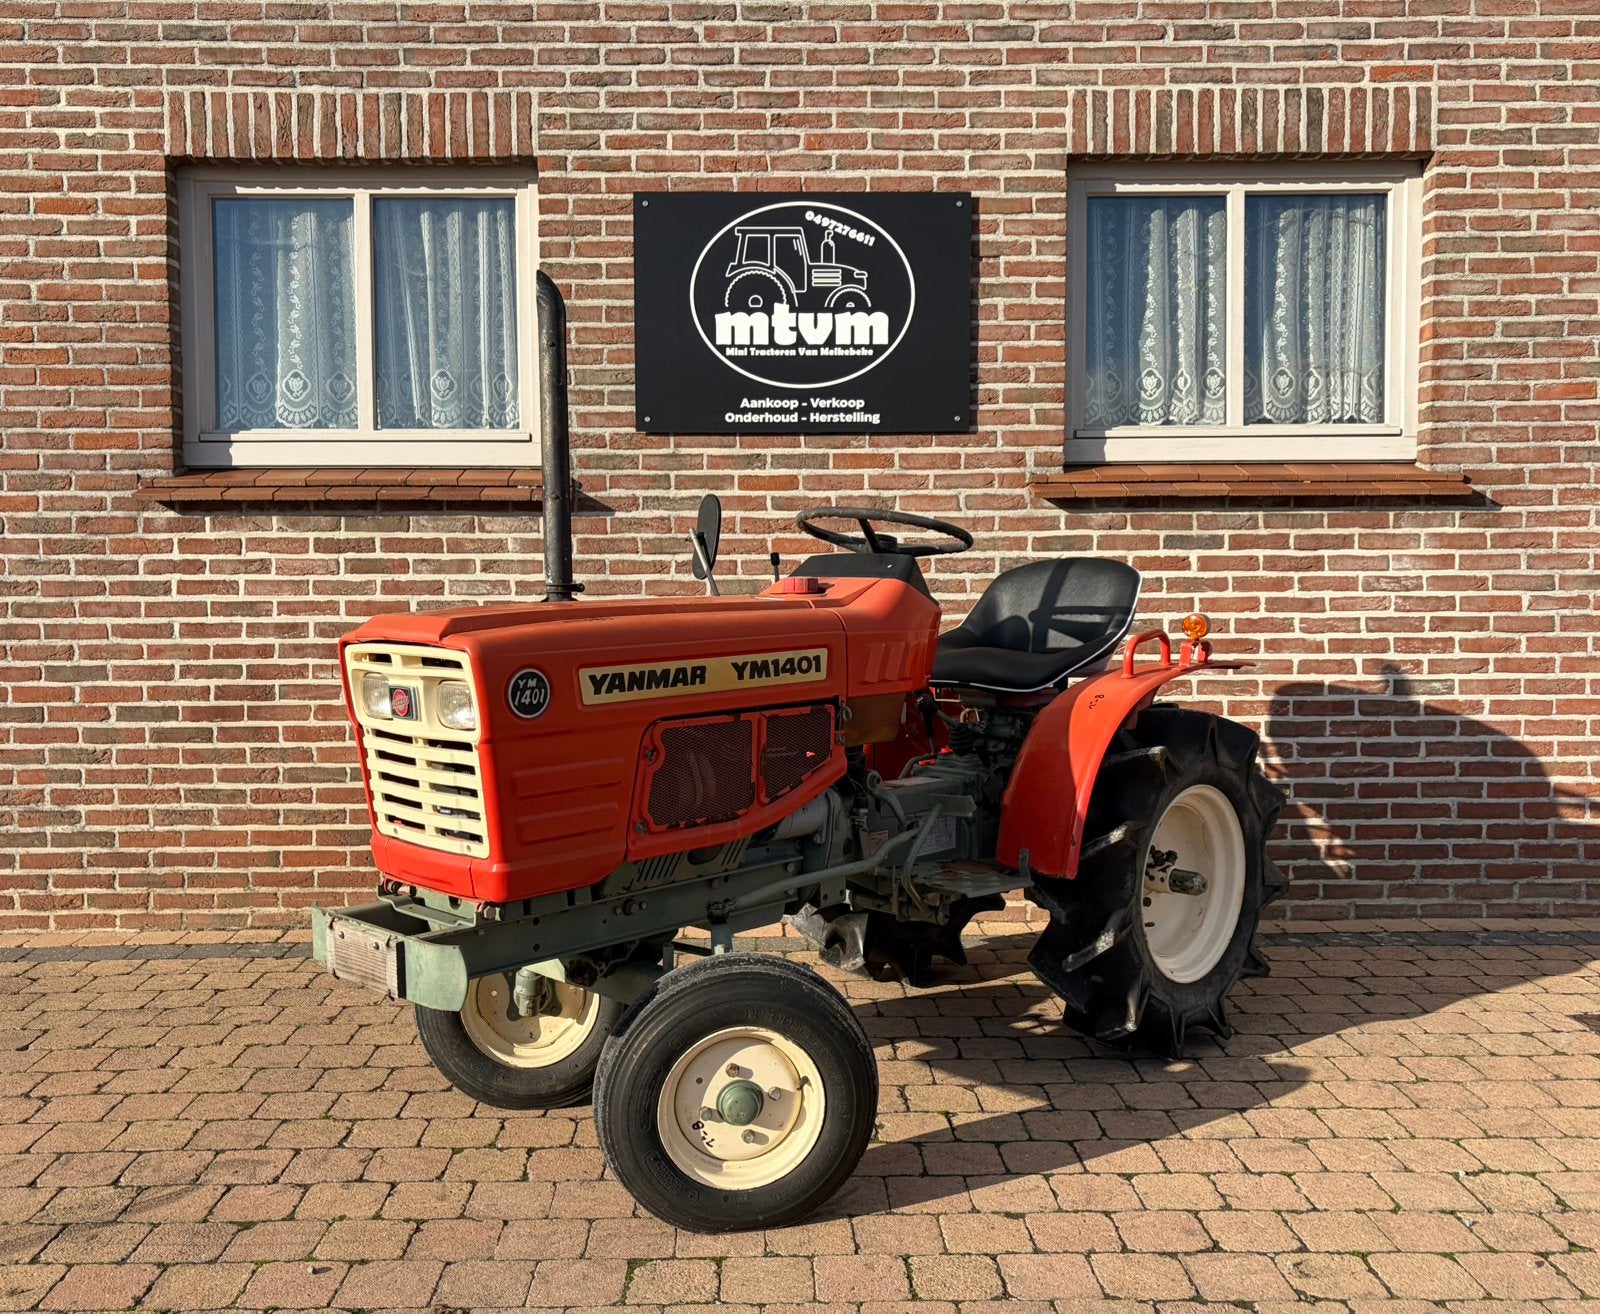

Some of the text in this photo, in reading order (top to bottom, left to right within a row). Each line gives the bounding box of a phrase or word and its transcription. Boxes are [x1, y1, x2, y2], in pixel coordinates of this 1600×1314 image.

[804, 210, 876, 247] 0497276611
[714, 302, 889, 346] mtvm
[725, 347, 748, 356] Mini
[749, 347, 797, 356] Tractoren
[798, 347, 819, 356] Van
[740, 397, 799, 409] Aankoop
[810, 397, 865, 409] Verkoop
[724, 411, 799, 423] Onderhoud
[810, 411, 881, 425] Herstelling
[588, 655, 822, 696] YANMAR YM1401
[514, 677, 546, 706] YM 1401
